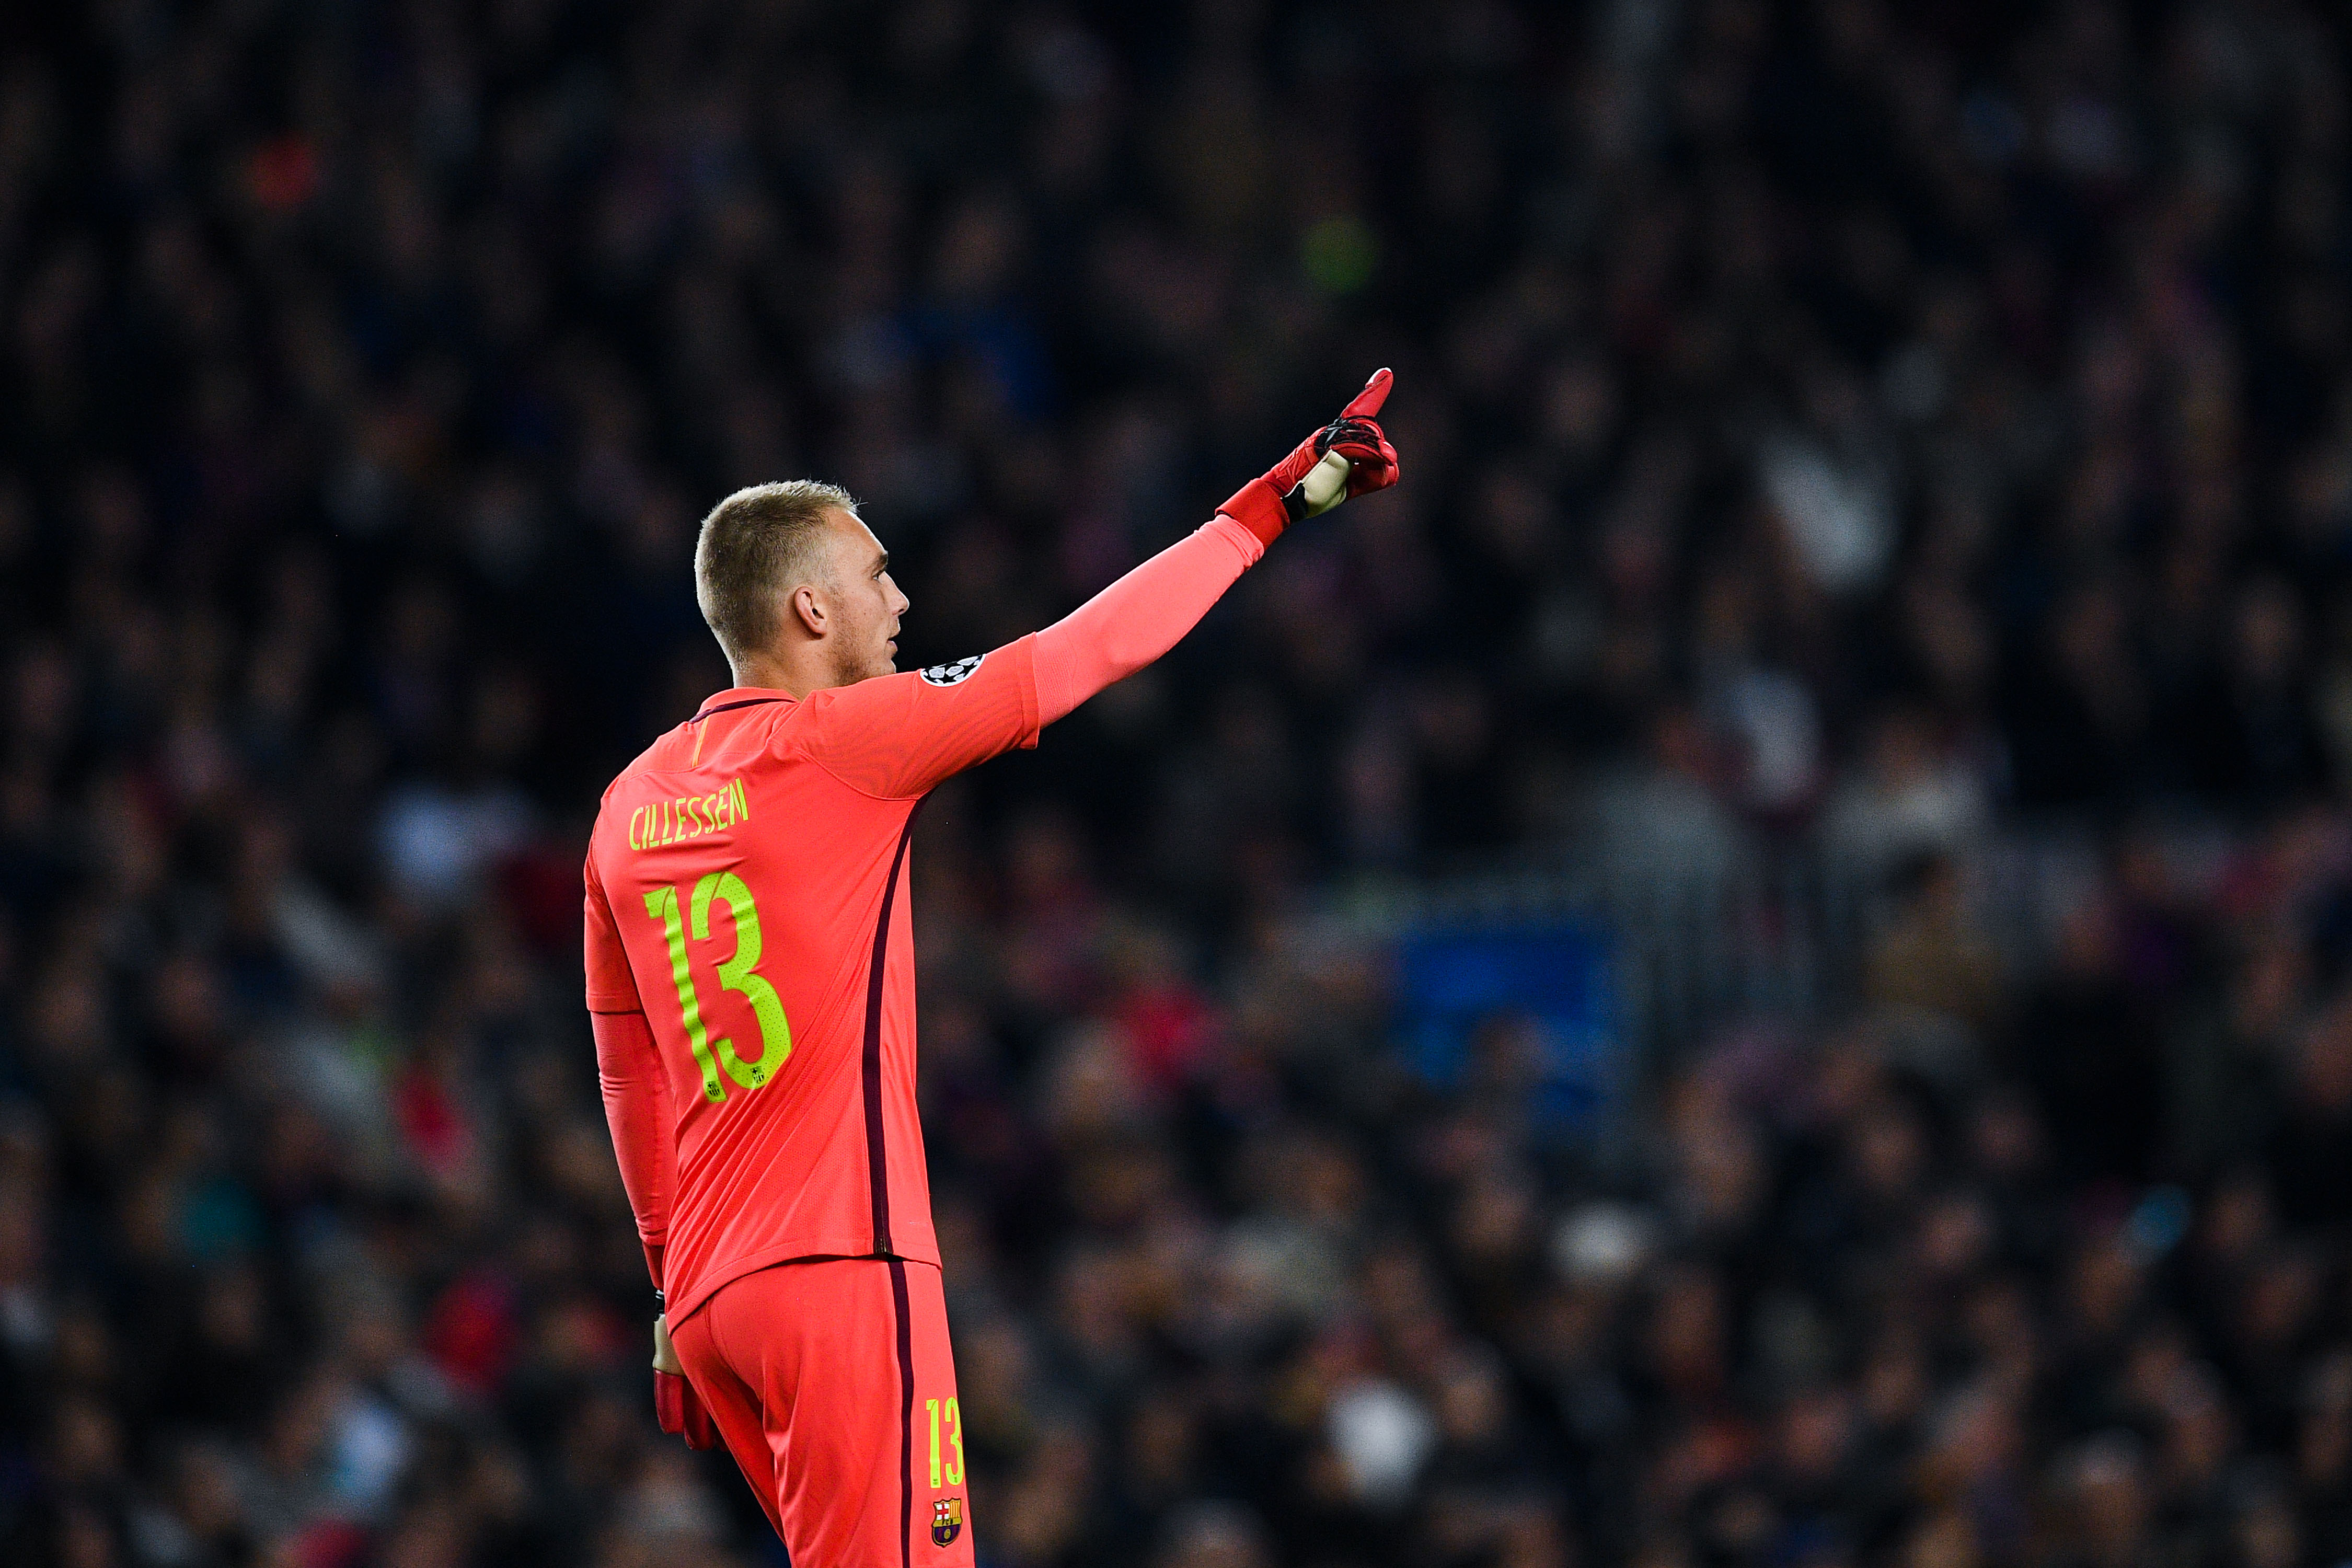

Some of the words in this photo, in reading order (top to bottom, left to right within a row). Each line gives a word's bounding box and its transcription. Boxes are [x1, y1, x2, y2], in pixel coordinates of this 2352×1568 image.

[629, 778, 748, 850] CILLESSEN
[643, 871, 792, 1102] 13
[926, 1397, 964, 1488] 13
